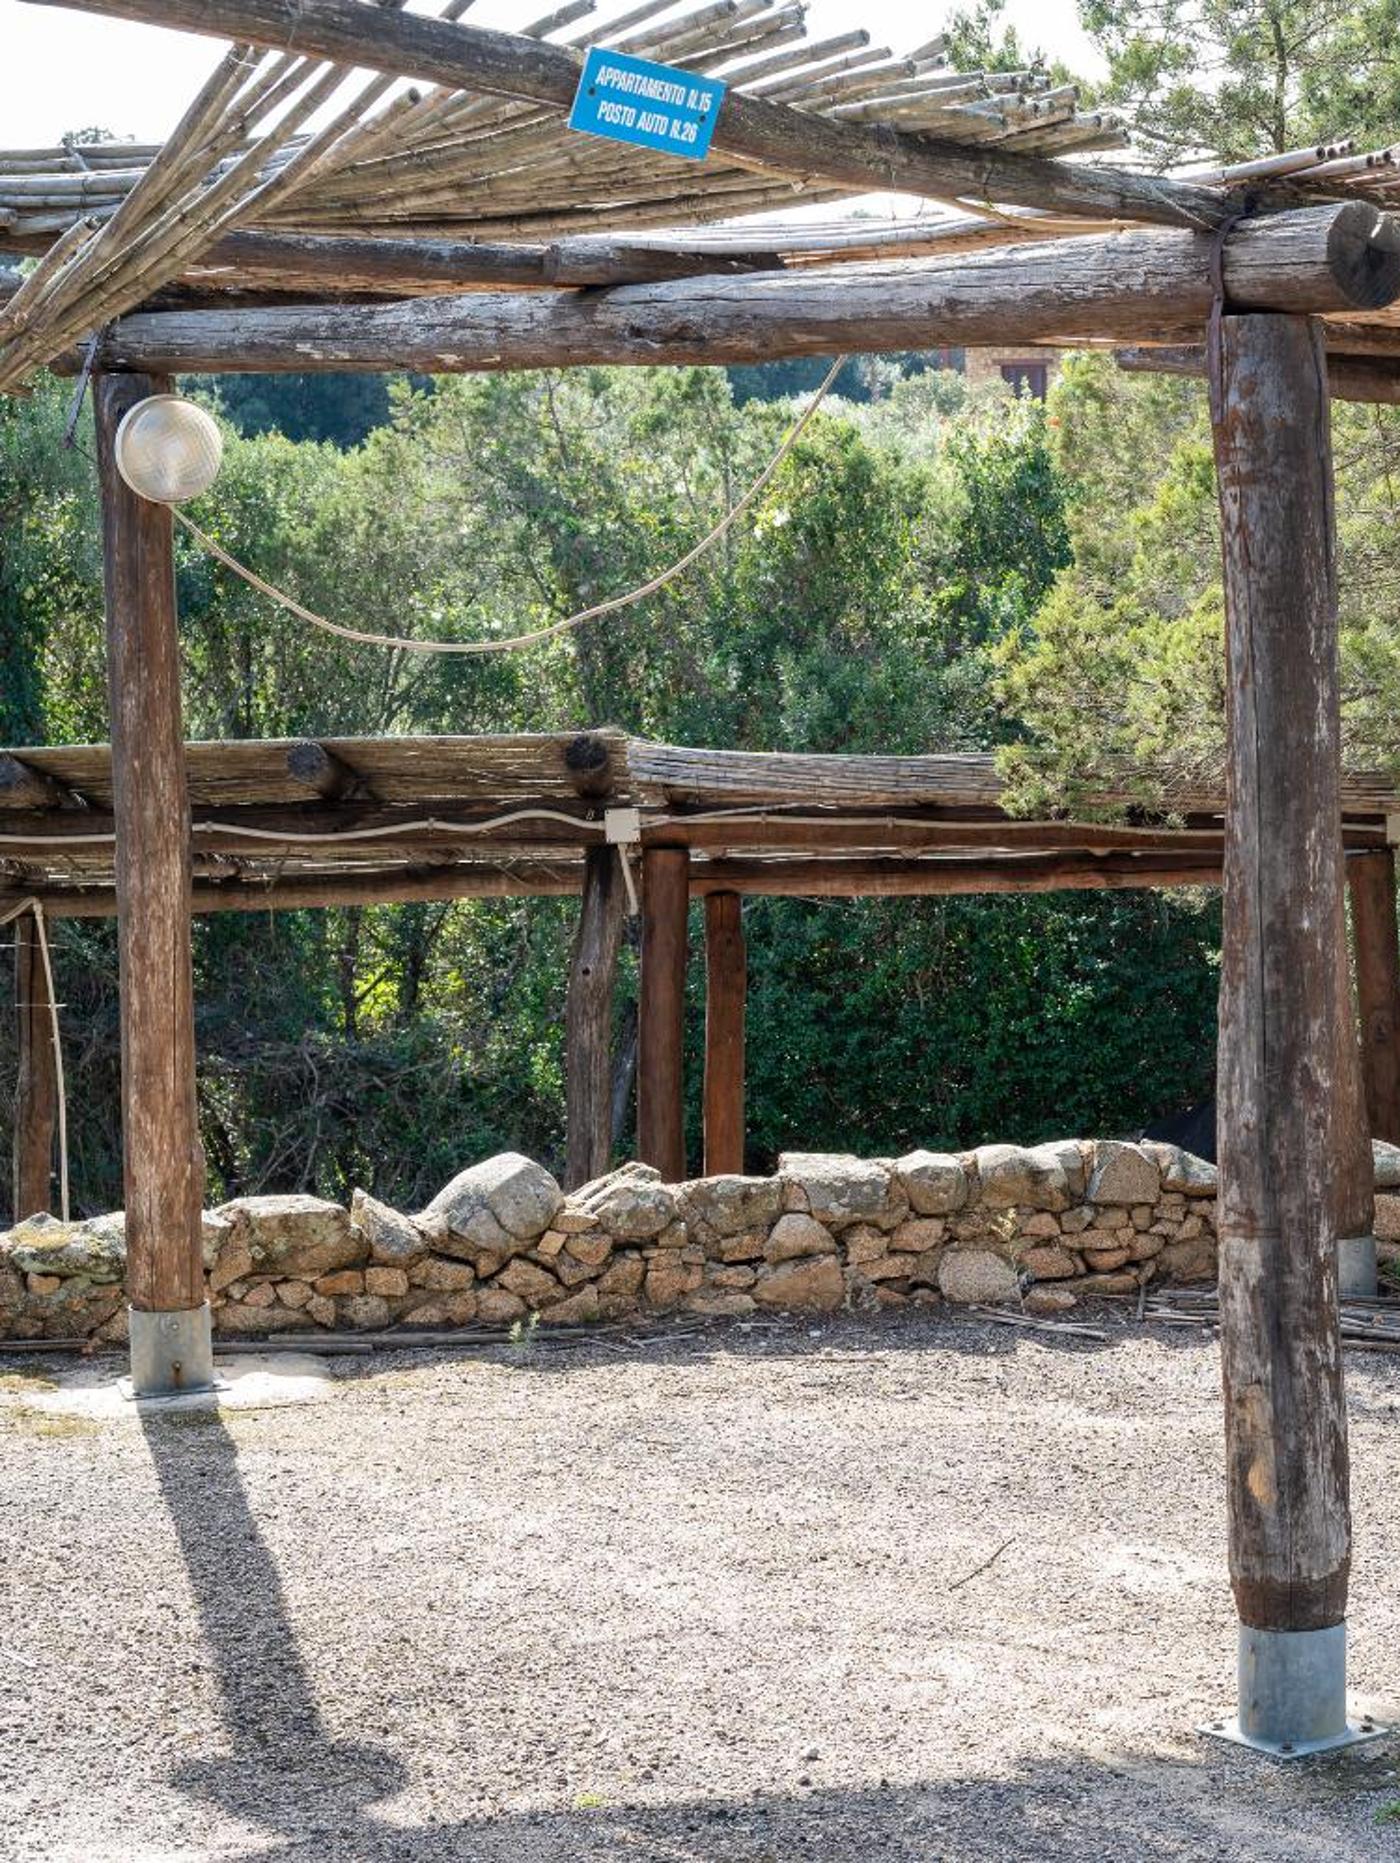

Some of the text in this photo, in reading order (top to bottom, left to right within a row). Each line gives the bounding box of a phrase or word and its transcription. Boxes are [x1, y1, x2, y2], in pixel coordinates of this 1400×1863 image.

[595, 65, 686, 105] APPARTAMENTO
[597, 100, 637, 127] POSTO
[636, 111, 668, 136] AUTO
